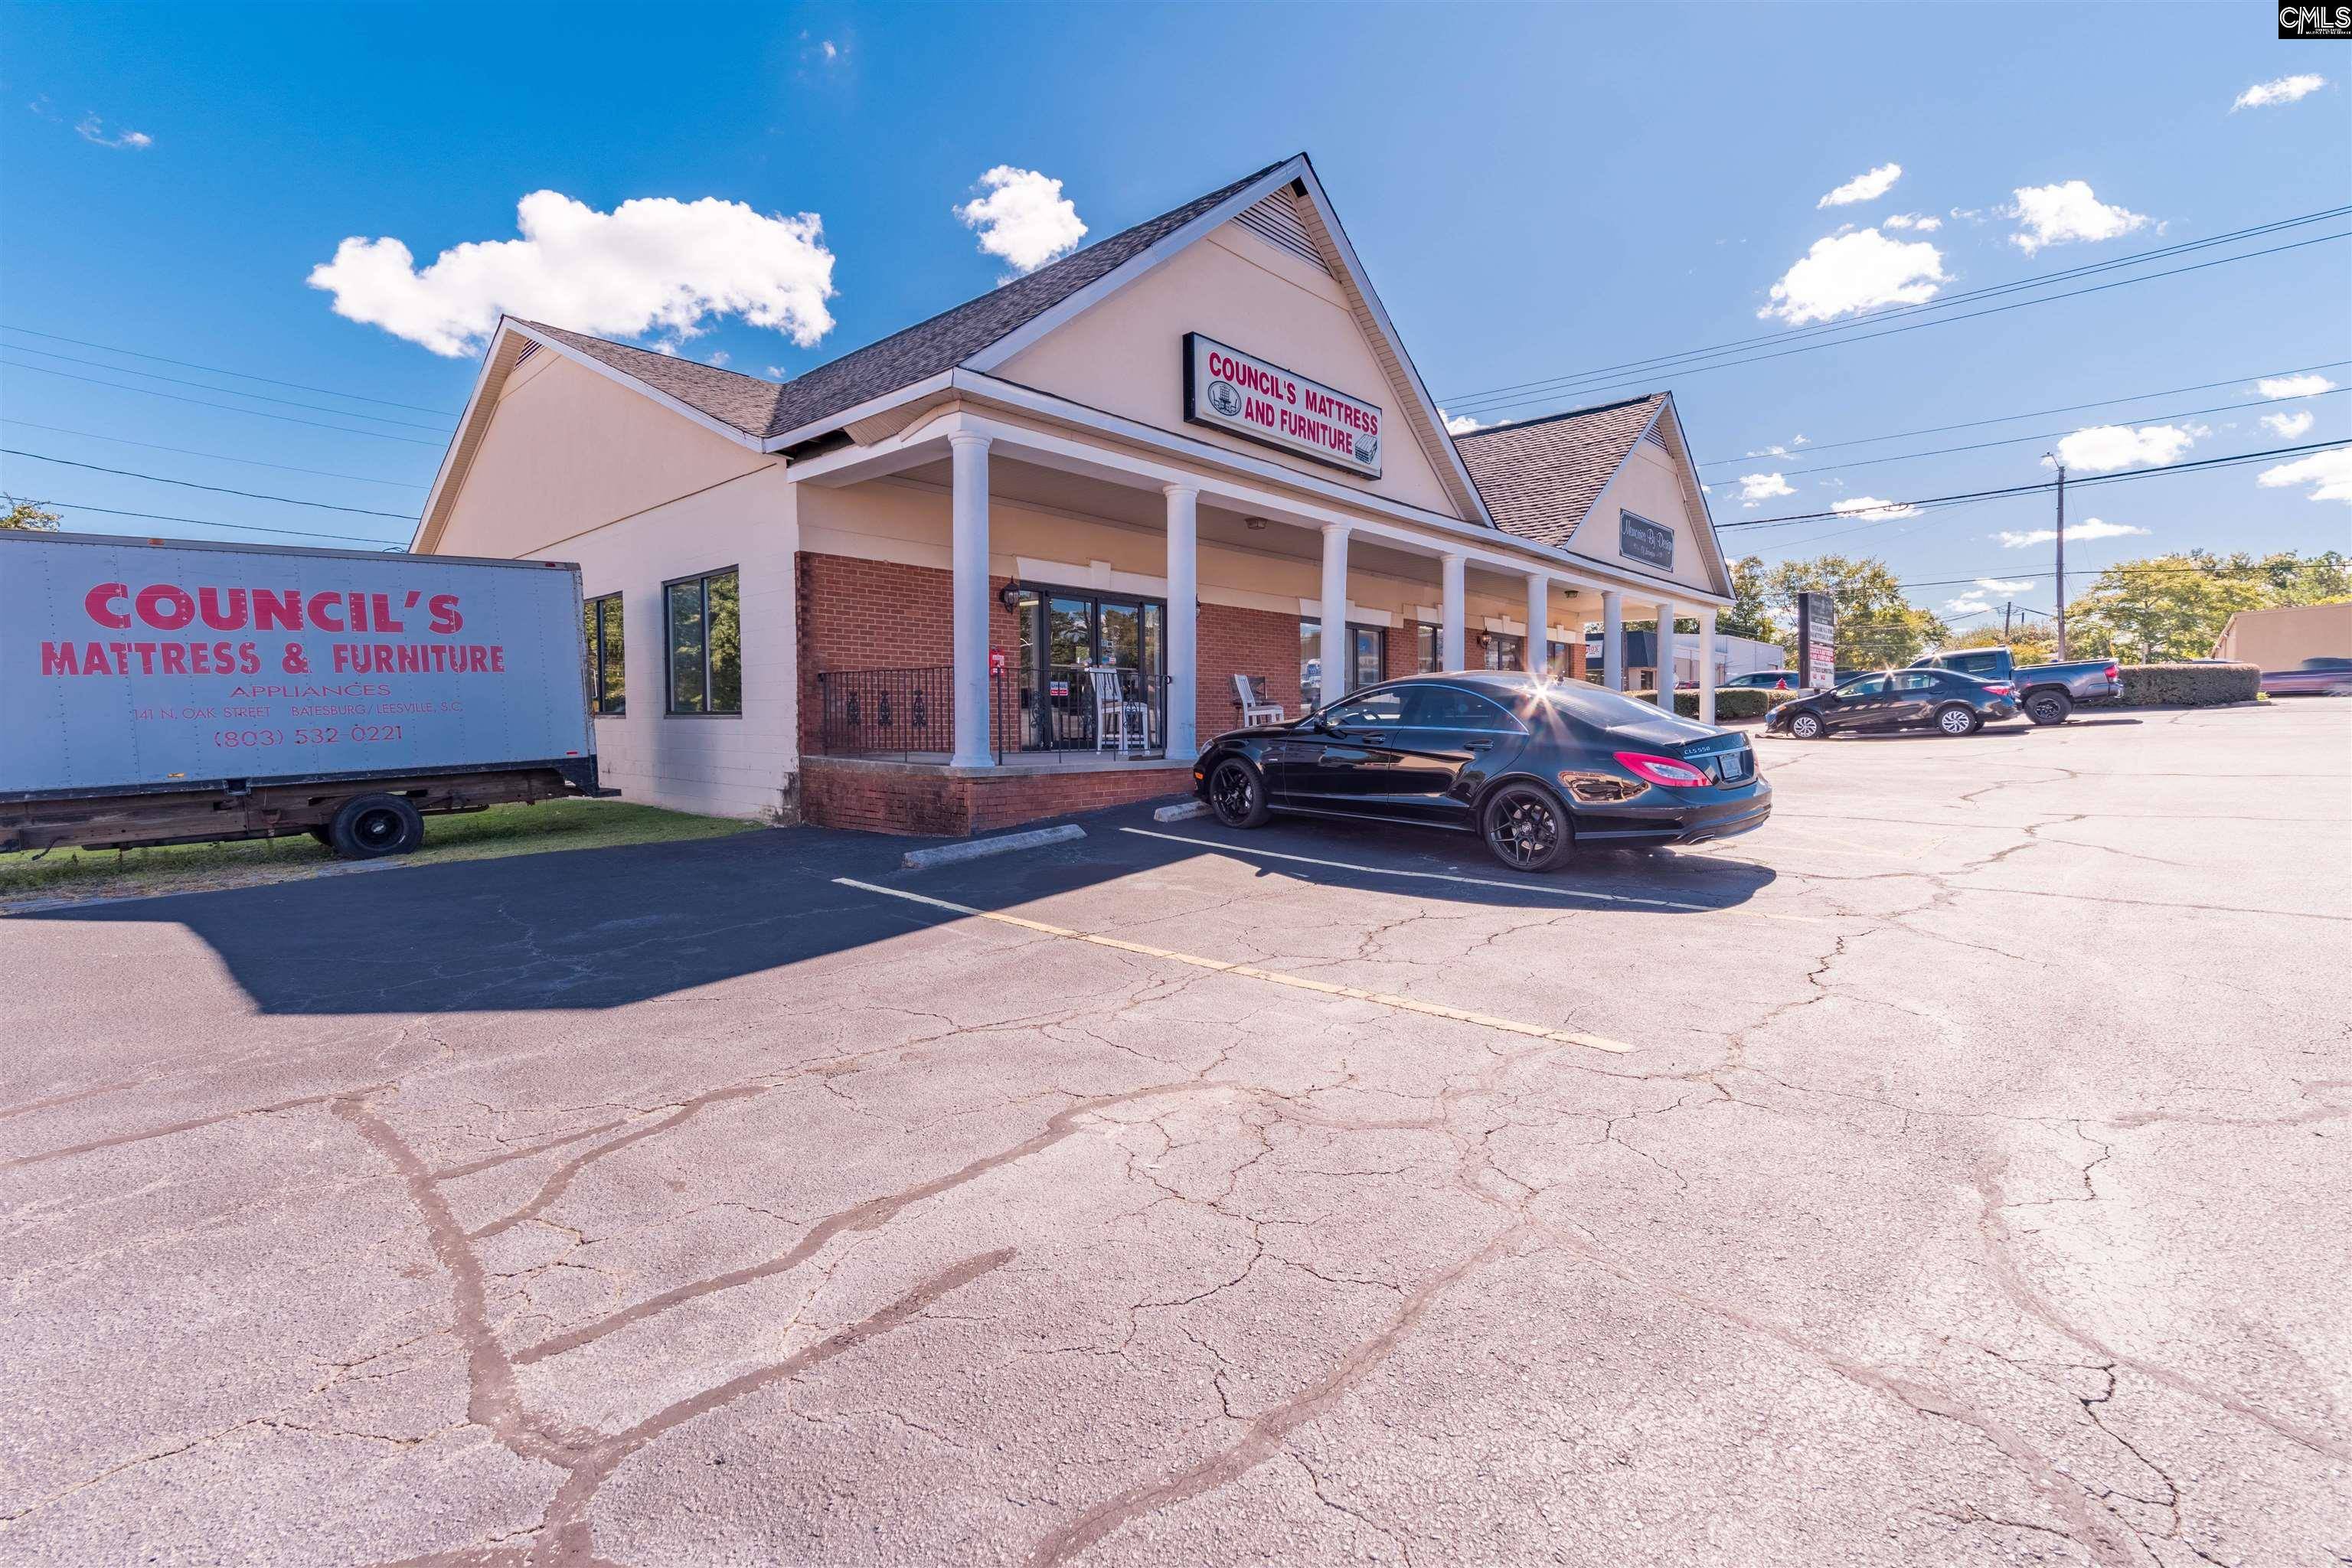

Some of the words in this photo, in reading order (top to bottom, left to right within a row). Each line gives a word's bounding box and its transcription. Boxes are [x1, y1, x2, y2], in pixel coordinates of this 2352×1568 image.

[1208, 351, 1297, 405] COUNCIL'S
[1305, 388, 1378, 436] MATTRESS
[1244, 397, 1276, 428] AND
[1280, 408, 1354, 455] FURNITURE
[84, 582, 464, 635] COUNCIL'S
[41, 641, 261, 676] MATTRESS
[282, 642, 312, 675] &
[332, 643, 506, 675] FURNITURE
[230, 684, 391, 698] APPLIANCES
[133, 708, 154, 720] 141
[160, 708, 178, 720] N.
[181, 707, 217, 720] OAK
[224, 707, 271, 718] STREET
[440, 701, 463, 712] S.C.
[214, 729, 283, 748] (803)
[294, 726, 403, 745] 532-0221
